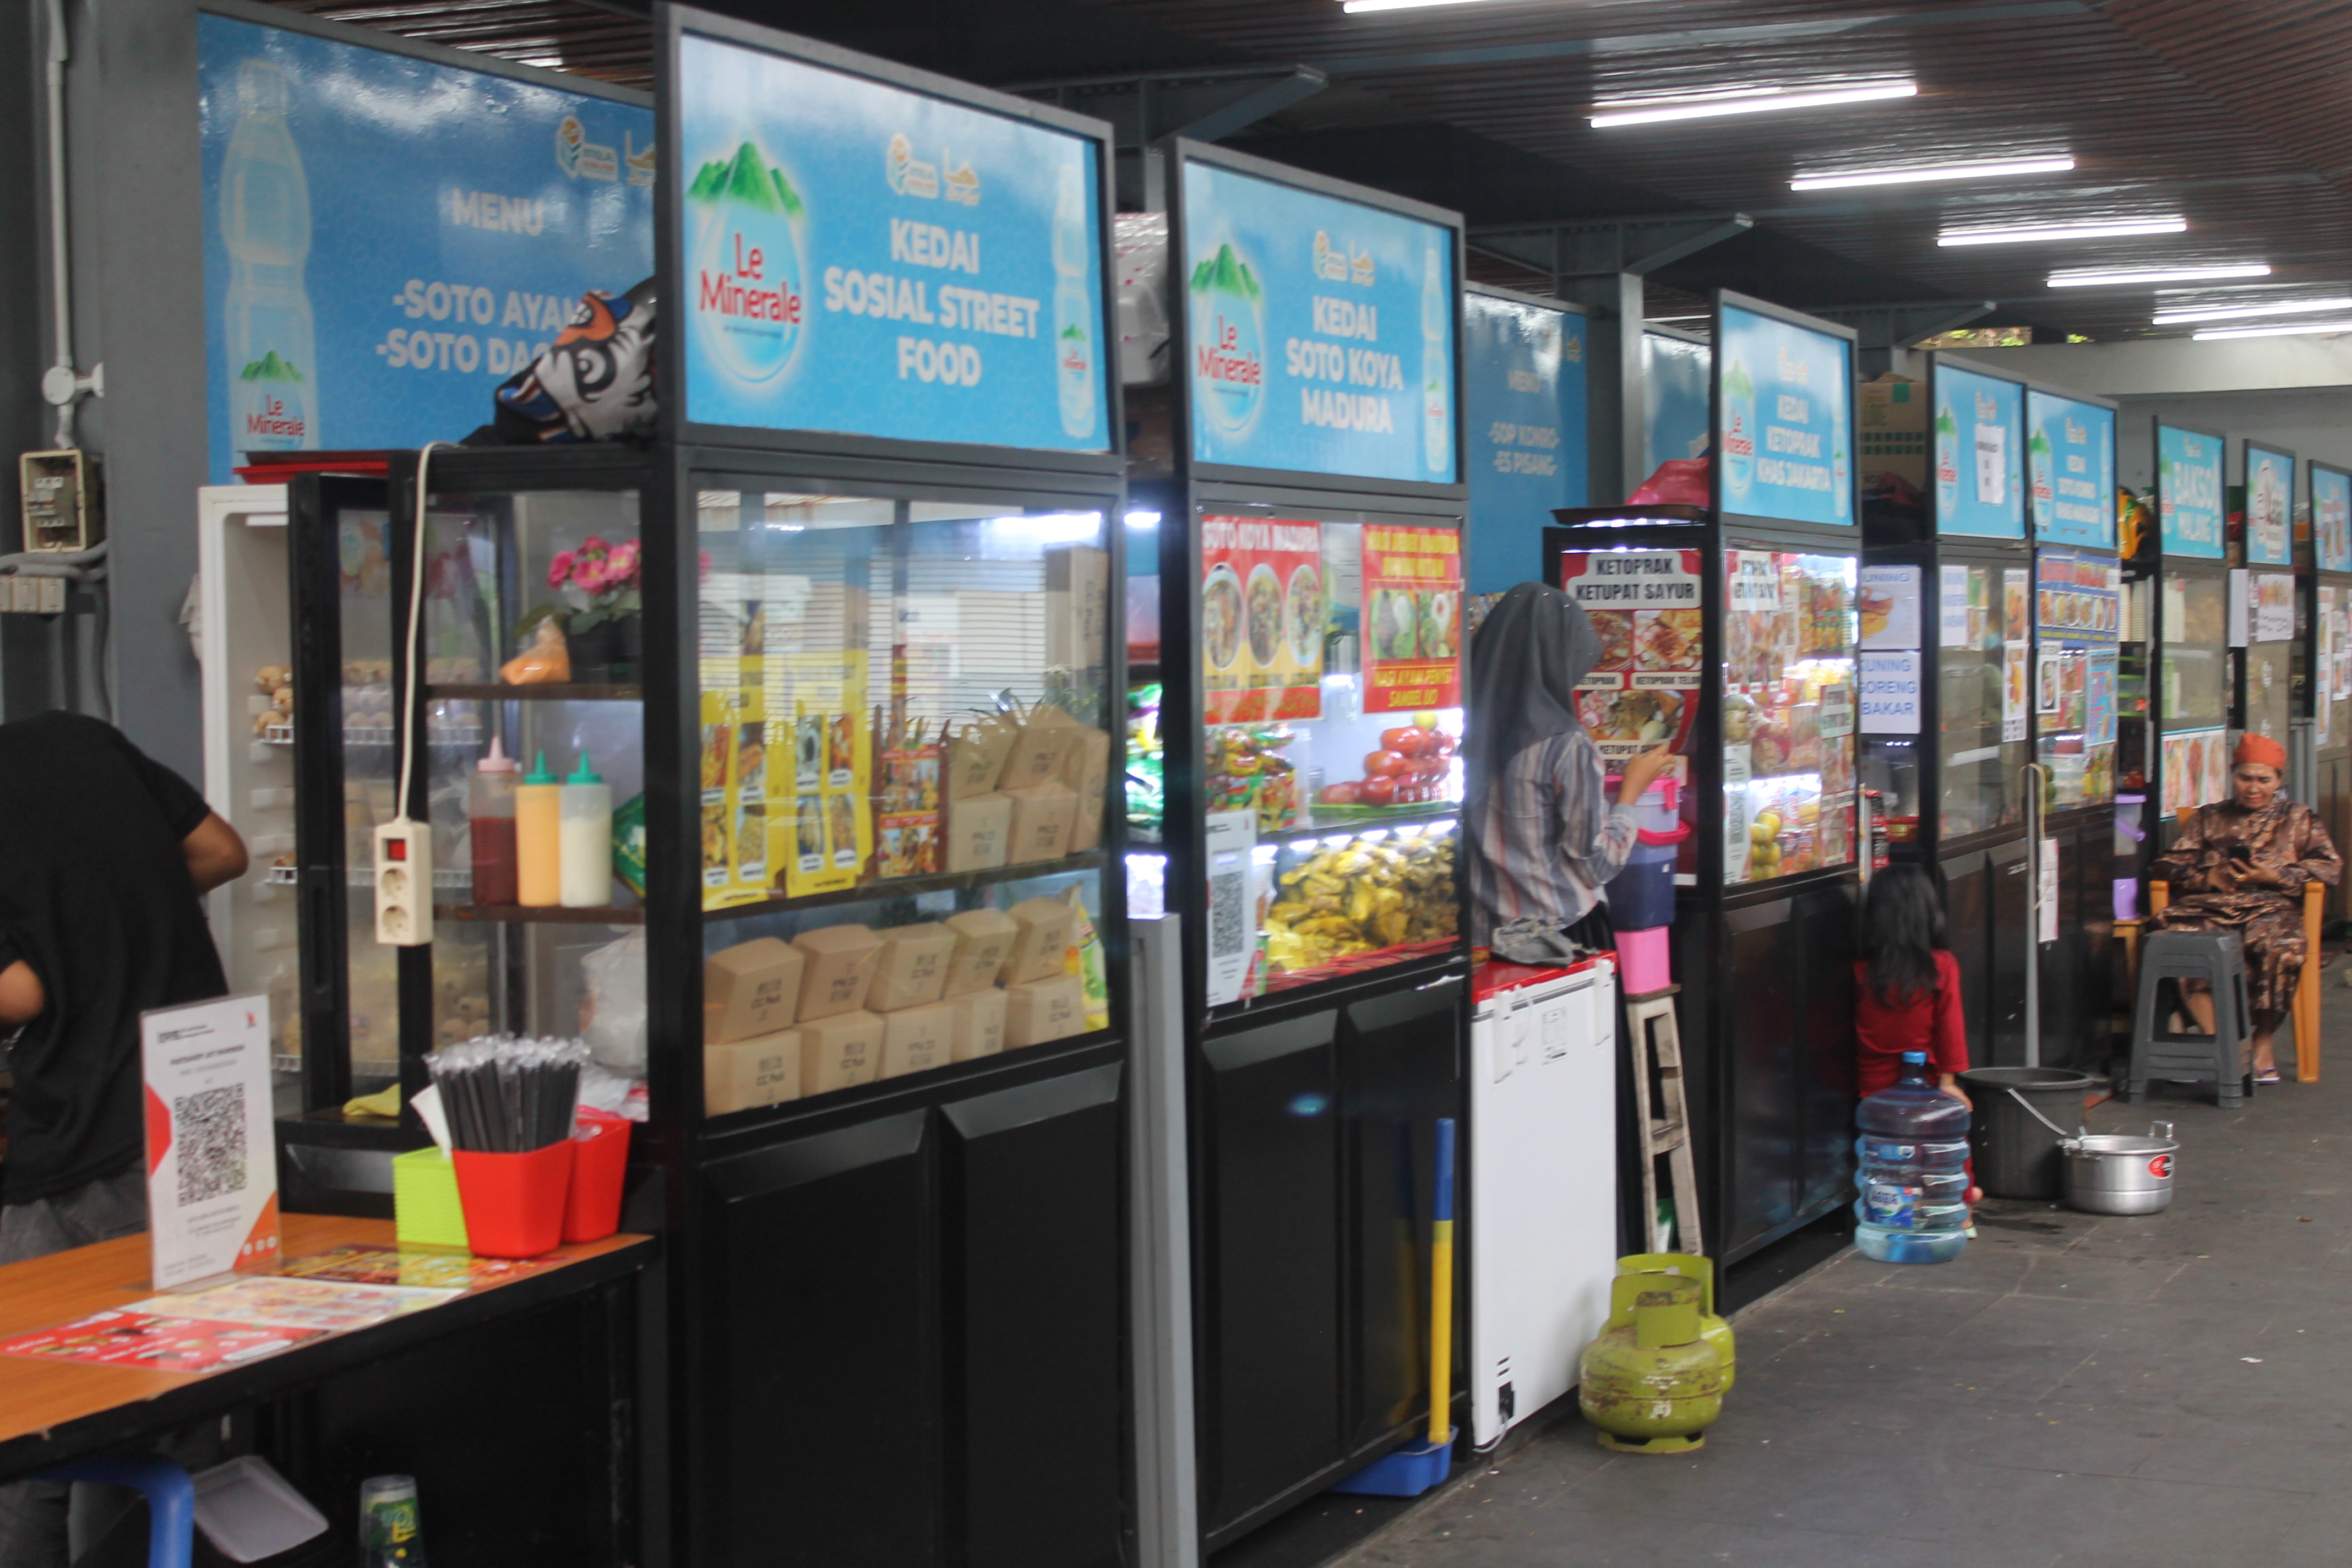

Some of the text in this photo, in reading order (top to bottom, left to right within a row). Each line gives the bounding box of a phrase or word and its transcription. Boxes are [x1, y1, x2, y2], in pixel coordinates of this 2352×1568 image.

[451, 188, 545, 237] MENU
[734, 232, 763, 280] Le
[890, 218, 980, 275] KEDAI
[699, 270, 803, 325] Minerale
[824, 265, 1041, 339] SOSIAL STREET
[1312, 295, 1377, 341] KEDAI
[1218, 315, 1237, 352] Le
[897, 336, 982, 386] FOOD
[1197, 344, 1261, 385] Minerale
[1286, 337, 1404, 391] SOTO KOYA
[246, 413, 305, 438] Minerale
[265, 393, 284, 416] Le
[1301, 387, 1394, 435] MADURA
[1595, 558, 1674, 575] KETOPRAK
[1575, 583, 1696, 601] KETUPAT SAYUR
[1861, 702, 1915, 715] BAKAR
